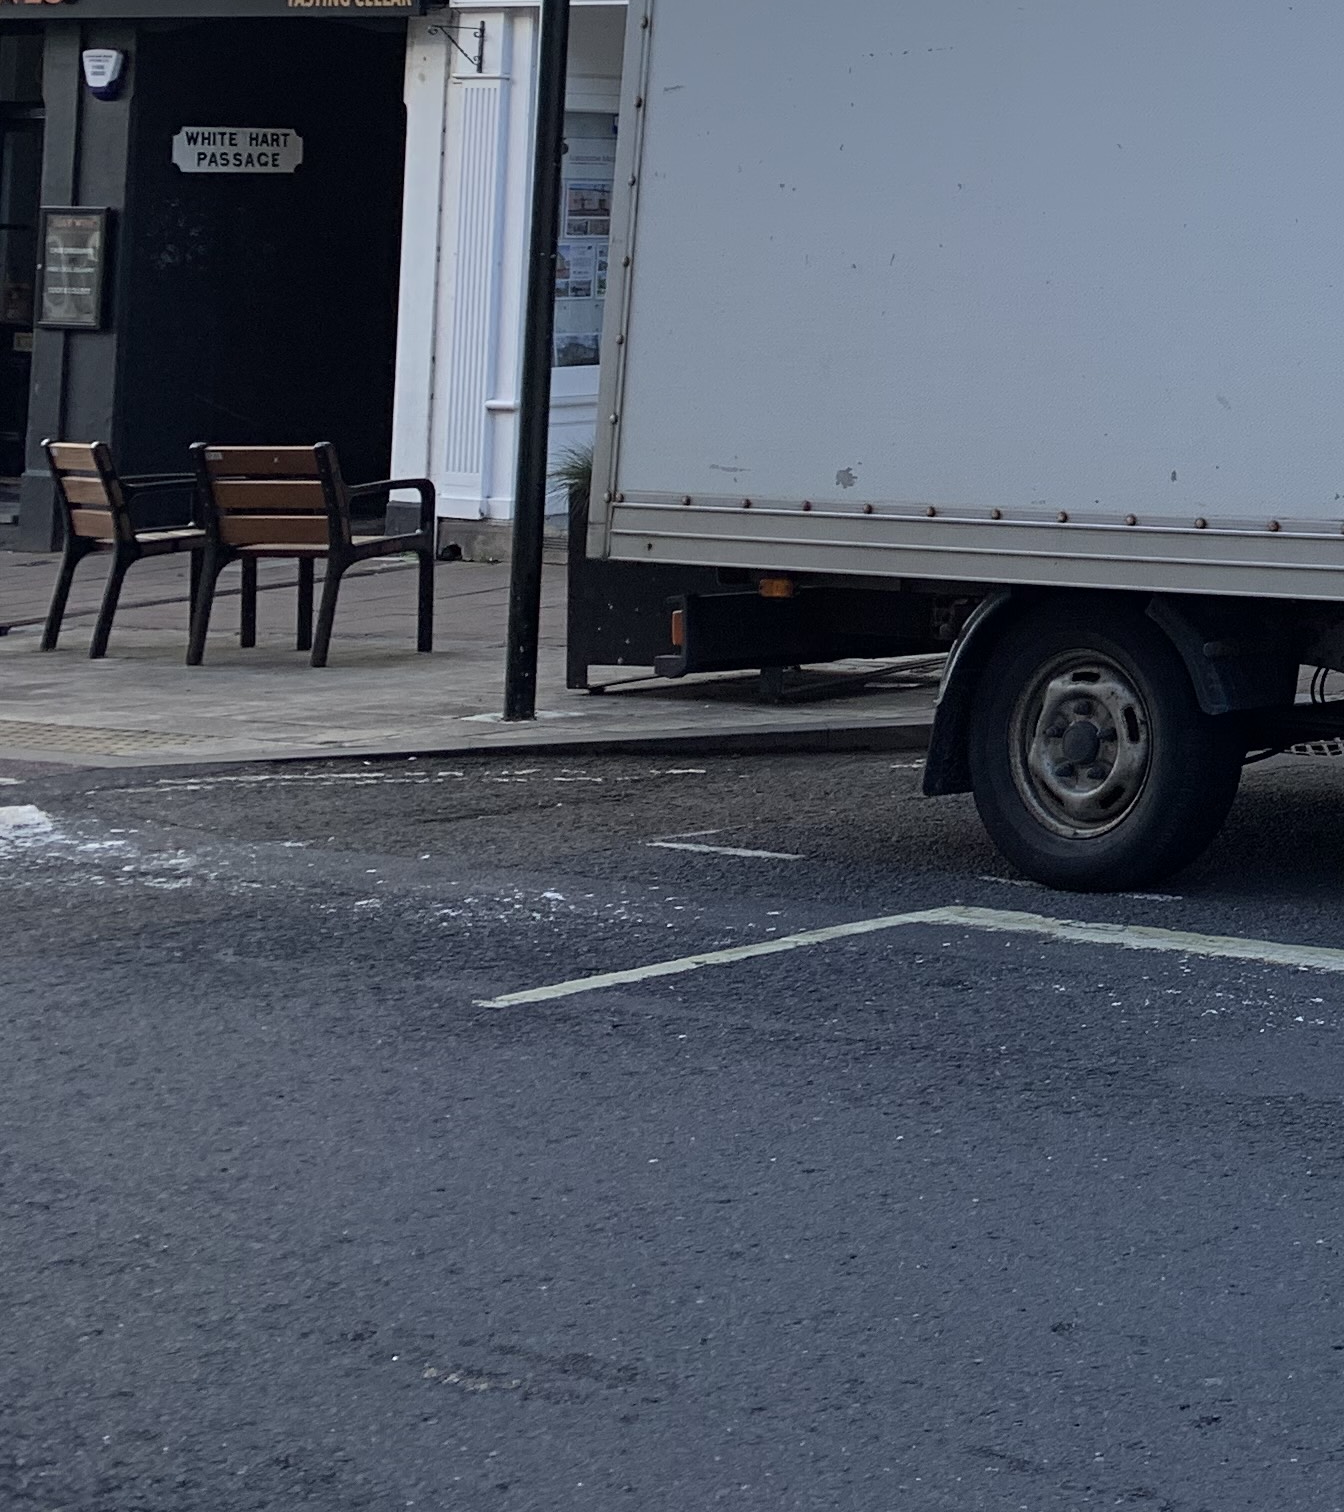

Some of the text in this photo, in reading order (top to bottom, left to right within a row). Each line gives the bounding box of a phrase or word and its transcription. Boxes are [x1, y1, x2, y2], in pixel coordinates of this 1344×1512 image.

[185, 132, 290, 147] WHITE HART
[197, 152, 280, 167] PASSAGE
